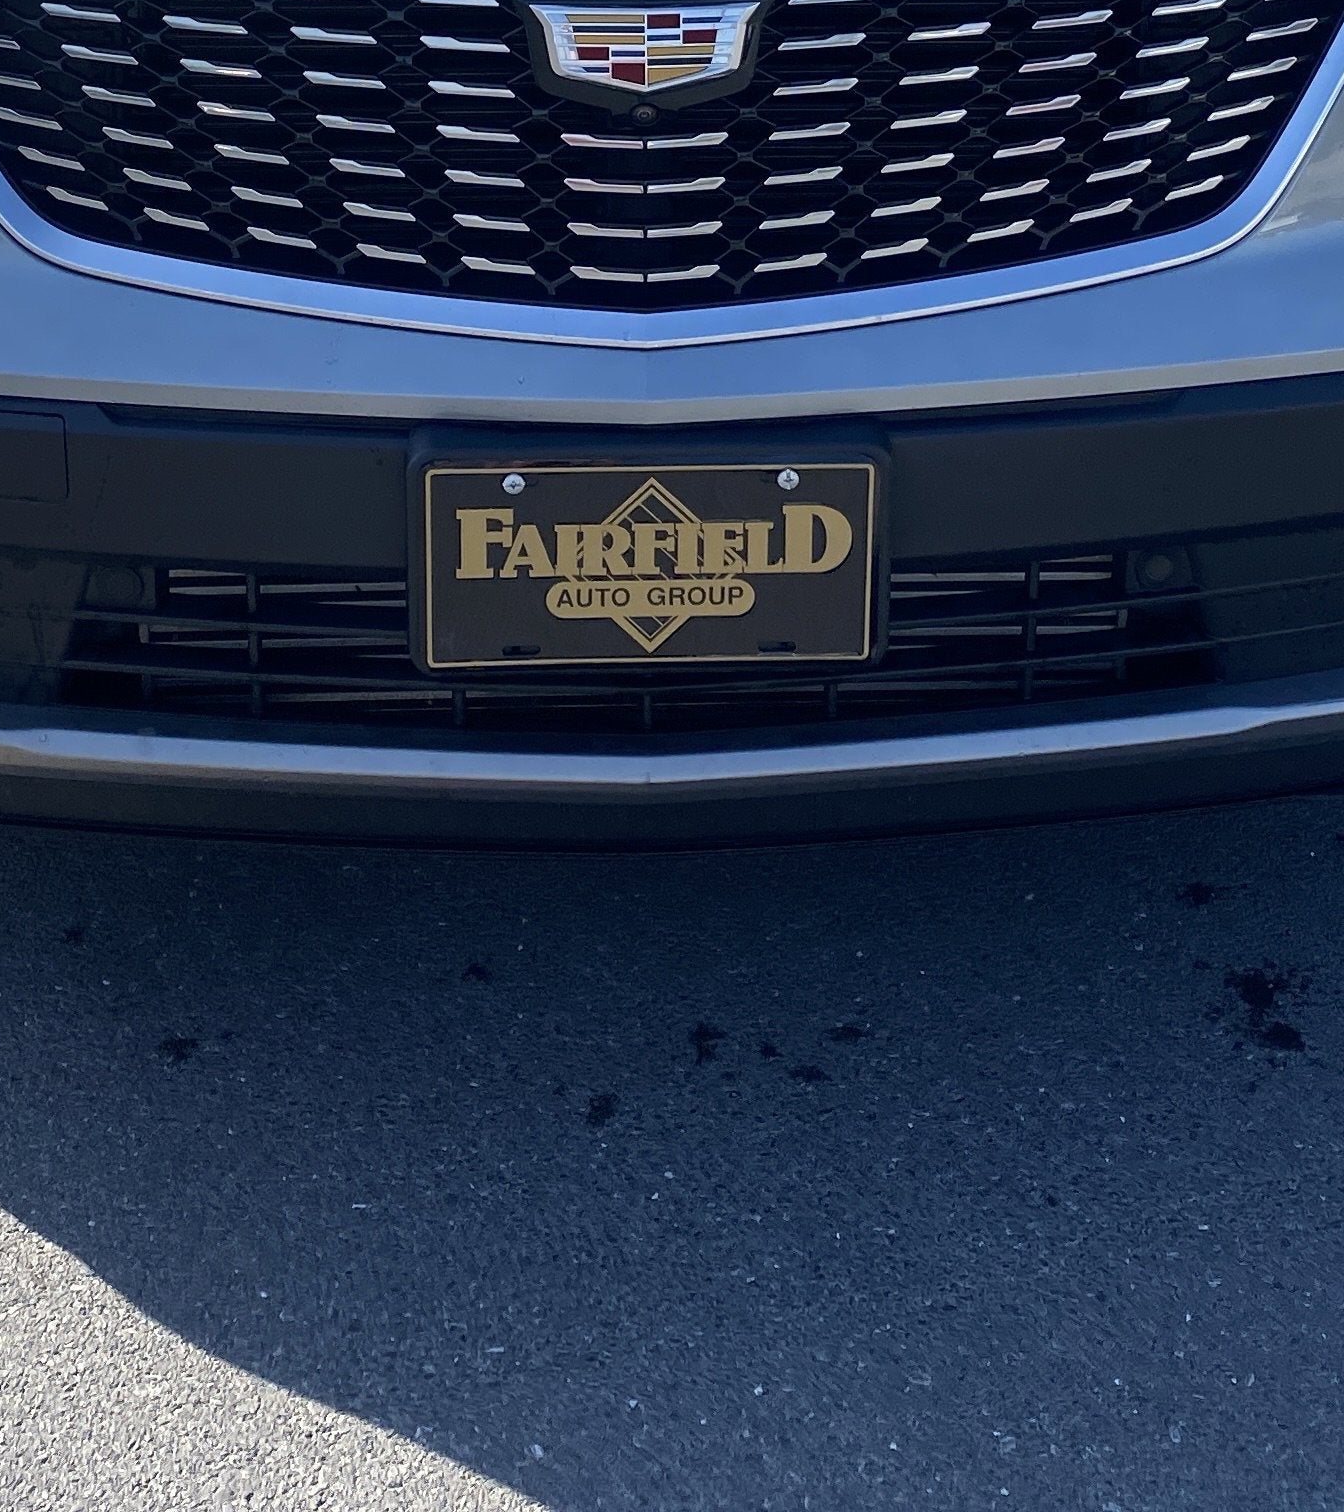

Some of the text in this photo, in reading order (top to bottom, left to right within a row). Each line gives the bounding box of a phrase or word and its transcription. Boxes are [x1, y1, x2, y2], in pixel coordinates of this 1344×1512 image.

[455, 503, 854, 580] FAIRFIELD
[556, 584, 746, 609] AUTO GROUP
